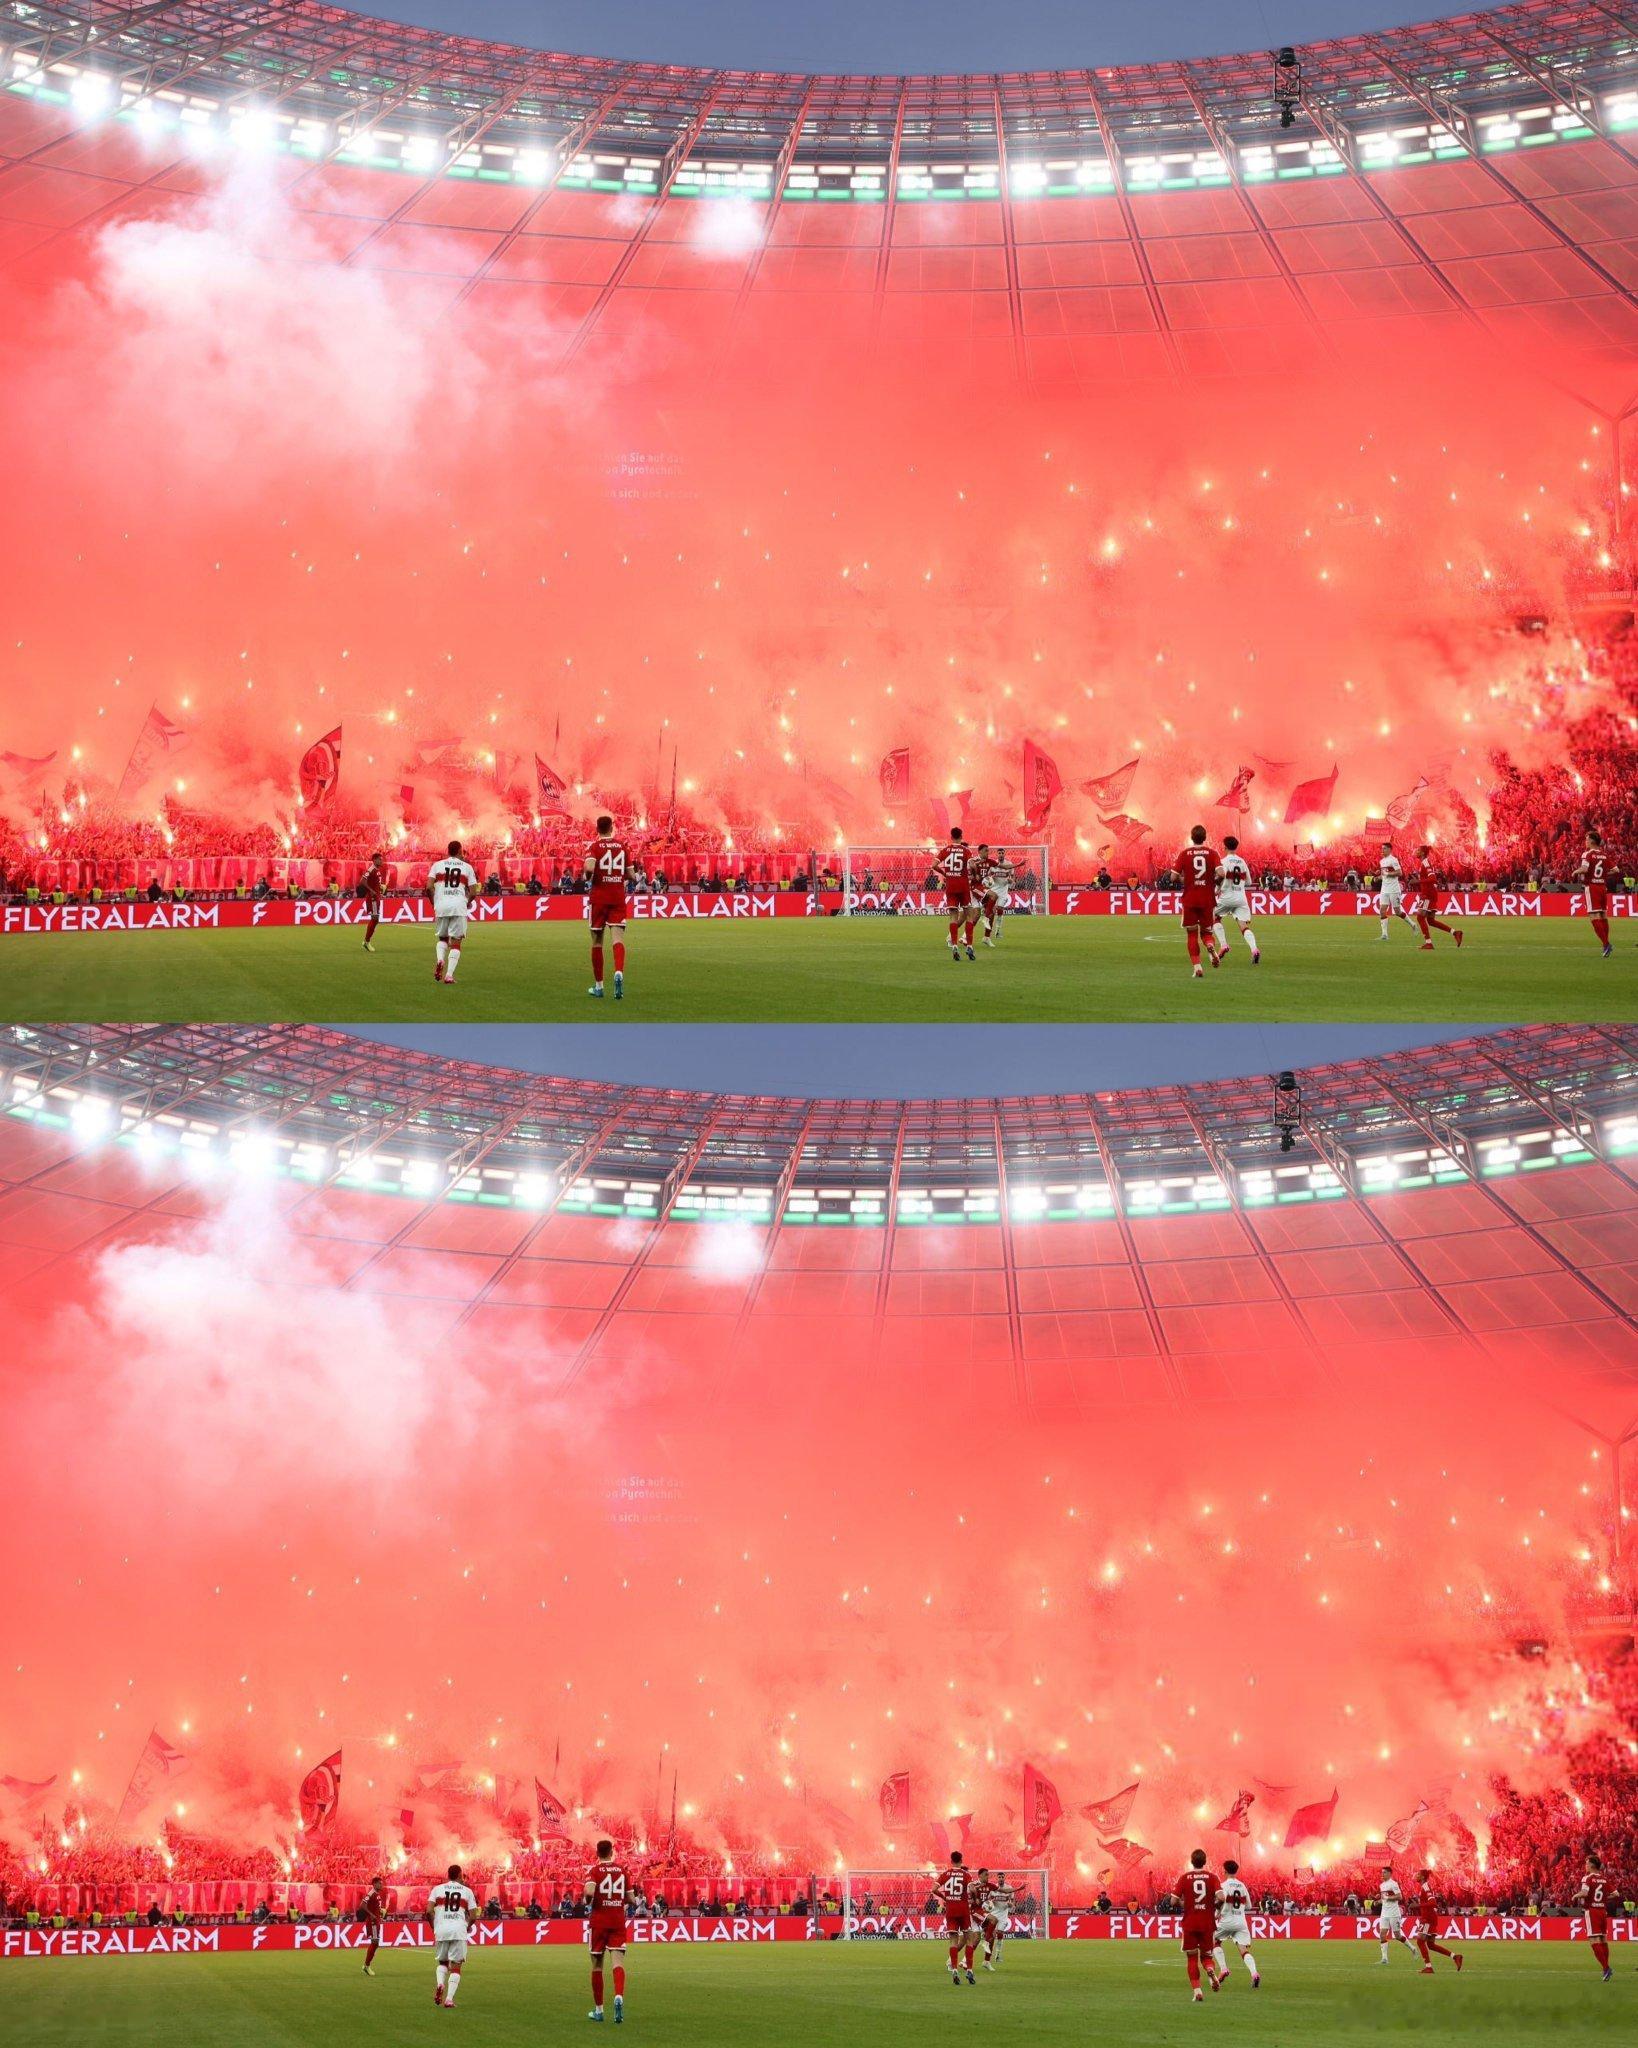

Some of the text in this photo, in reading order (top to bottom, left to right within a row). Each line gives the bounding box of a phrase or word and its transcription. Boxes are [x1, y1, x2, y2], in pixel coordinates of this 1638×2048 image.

[630, 453, 646, 463] Sie
[618, 488, 640, 498] sich
[599, 849, 625, 876] 44
[944, 853, 964, 872] 45
[1193, 855, 1206, 879] 9
[1594, 860, 1603, 878] 6
[444, 867, 462, 888] 18
[3, 902, 219, 932] FLYERALARM
[294, 898, 505, 925] POKALALRM
[1356, 893, 1541, 915] POKAALARM
[901, 907, 929, 916] ERGO
[630, 1477, 646, 1487] Sie
[618, 1512, 640, 1522] sich
[599, 1873, 625, 1900] 44
[944, 1877, 964, 1896] 45
[1193, 1879, 1206, 1903] 9
[1594, 1884, 1603, 1902] 6
[444, 1891, 462, 1912] 18
[3, 1926, 219, 1956] FLYERALARM
[294, 1922, 505, 1949] POKALALRM
[1356, 1917, 1541, 1939] POKAALARM
[901, 1931, 929, 1940] ERGO
